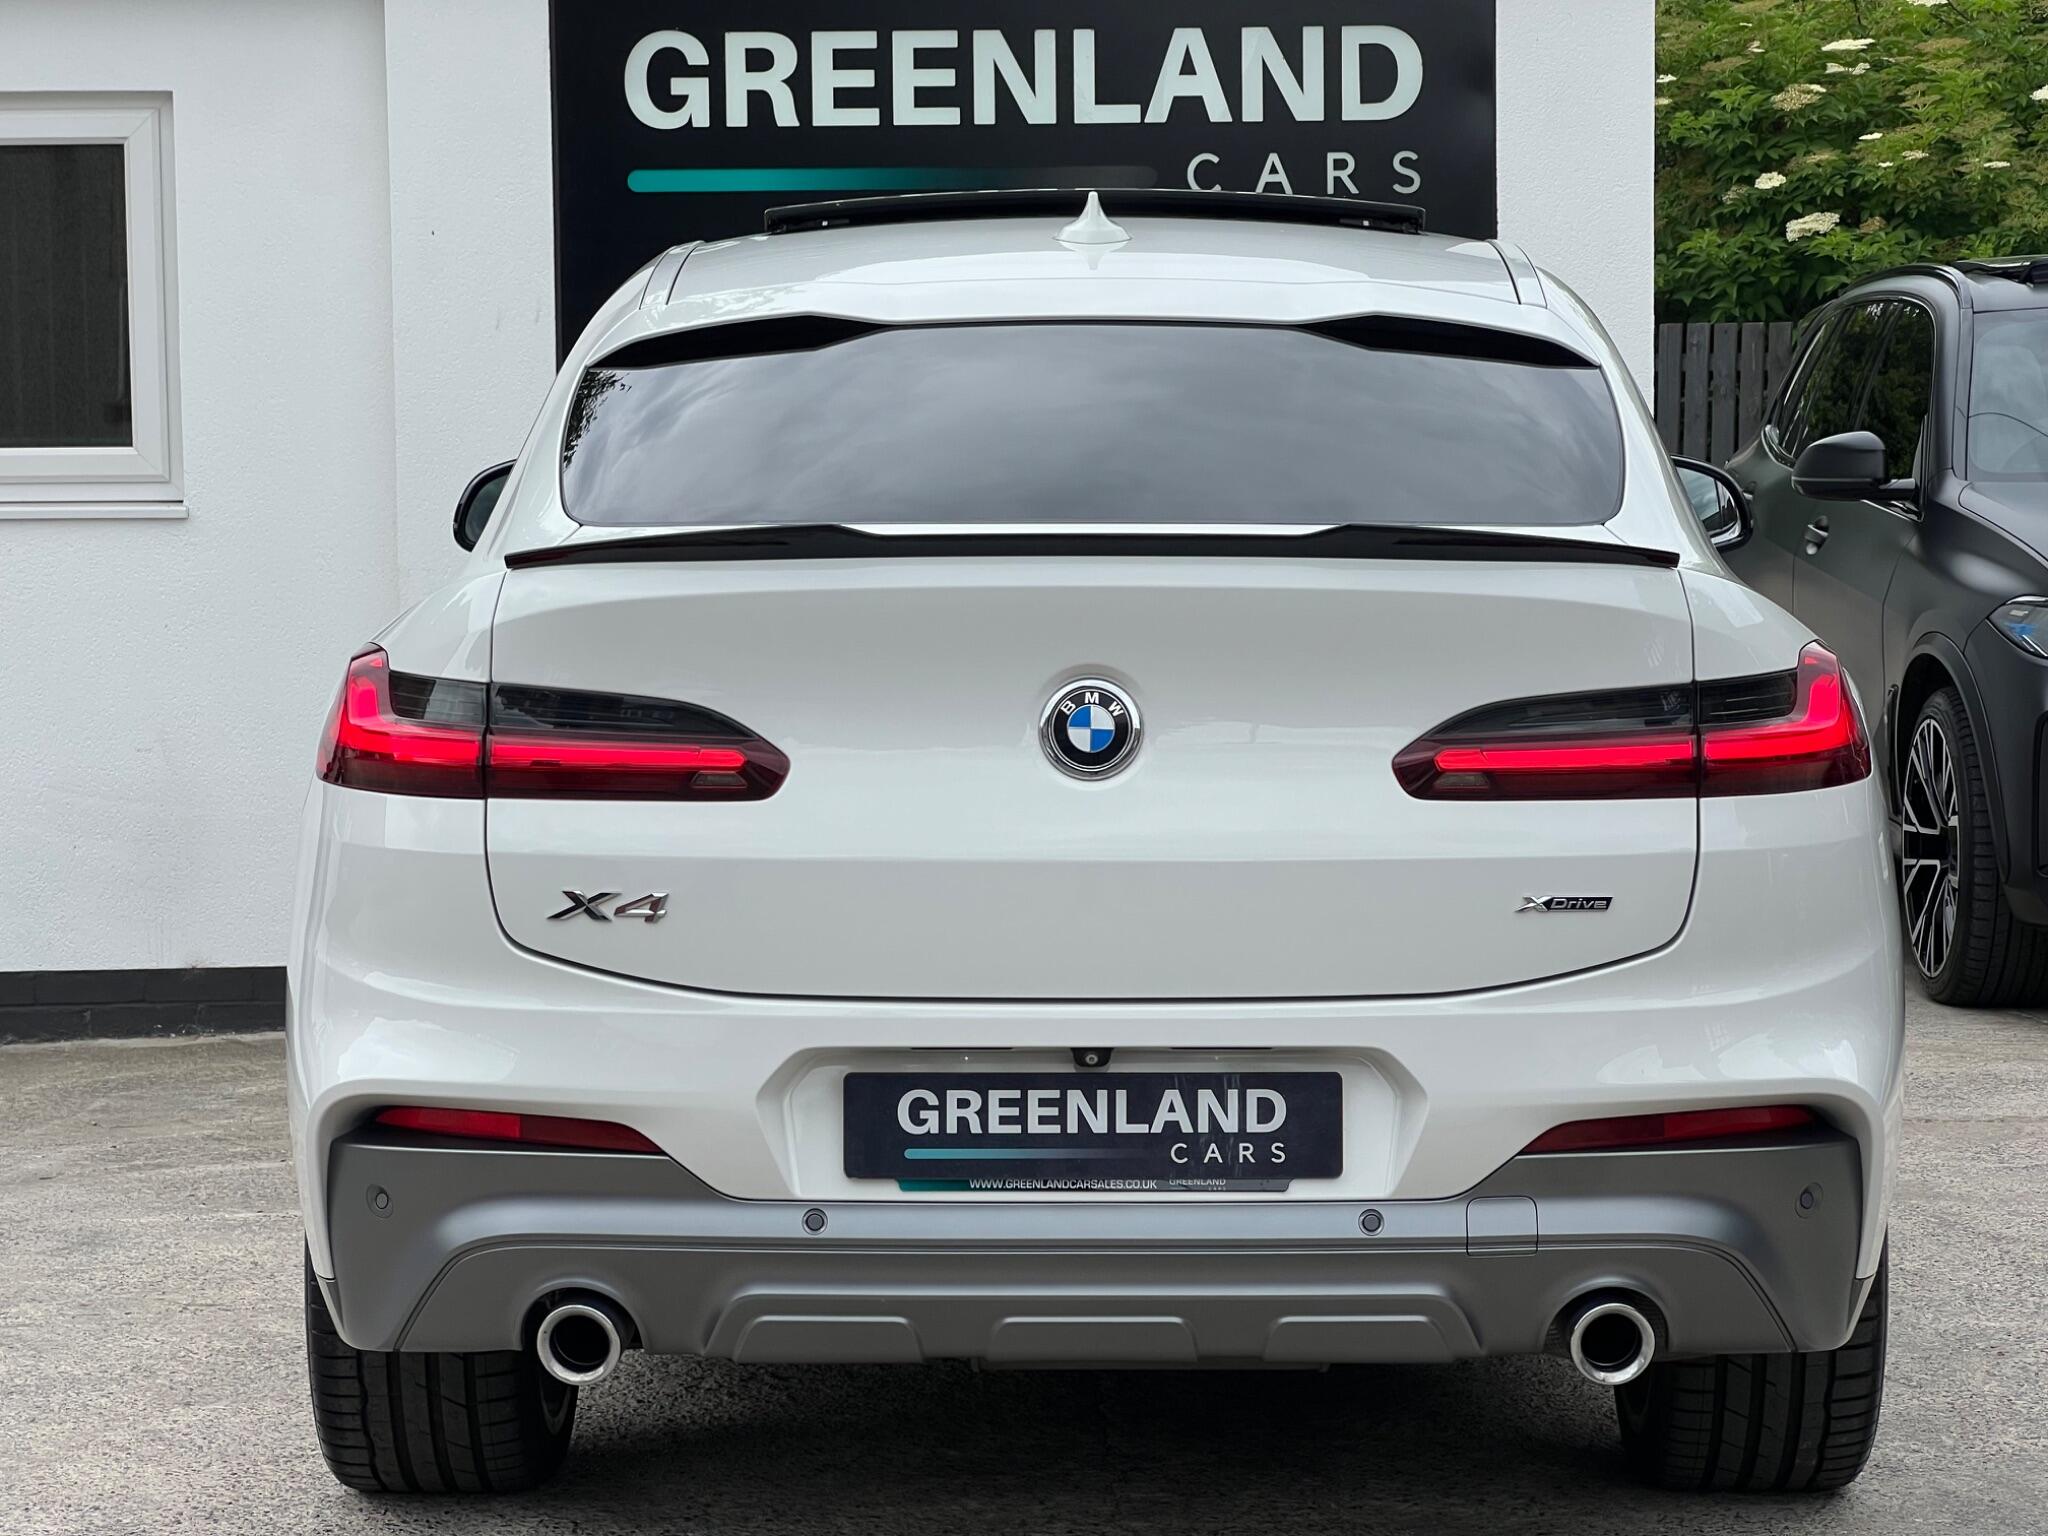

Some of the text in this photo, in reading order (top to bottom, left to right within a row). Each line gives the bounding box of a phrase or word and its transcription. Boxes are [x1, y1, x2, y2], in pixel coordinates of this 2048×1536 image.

[624, 26, 1424, 130] GREENLAND
[1187, 150, 1421, 195] CARS
[1060, 692, 1124, 717] BMW
[547, 890, 669, 923] X4
[897, 1089, 1287, 1135] GREENLAND
[1170, 1143, 1287, 1164] CARS
[969, 1178, 1158, 1190] WWW.GREENLANDCARSALES.CO.UK
